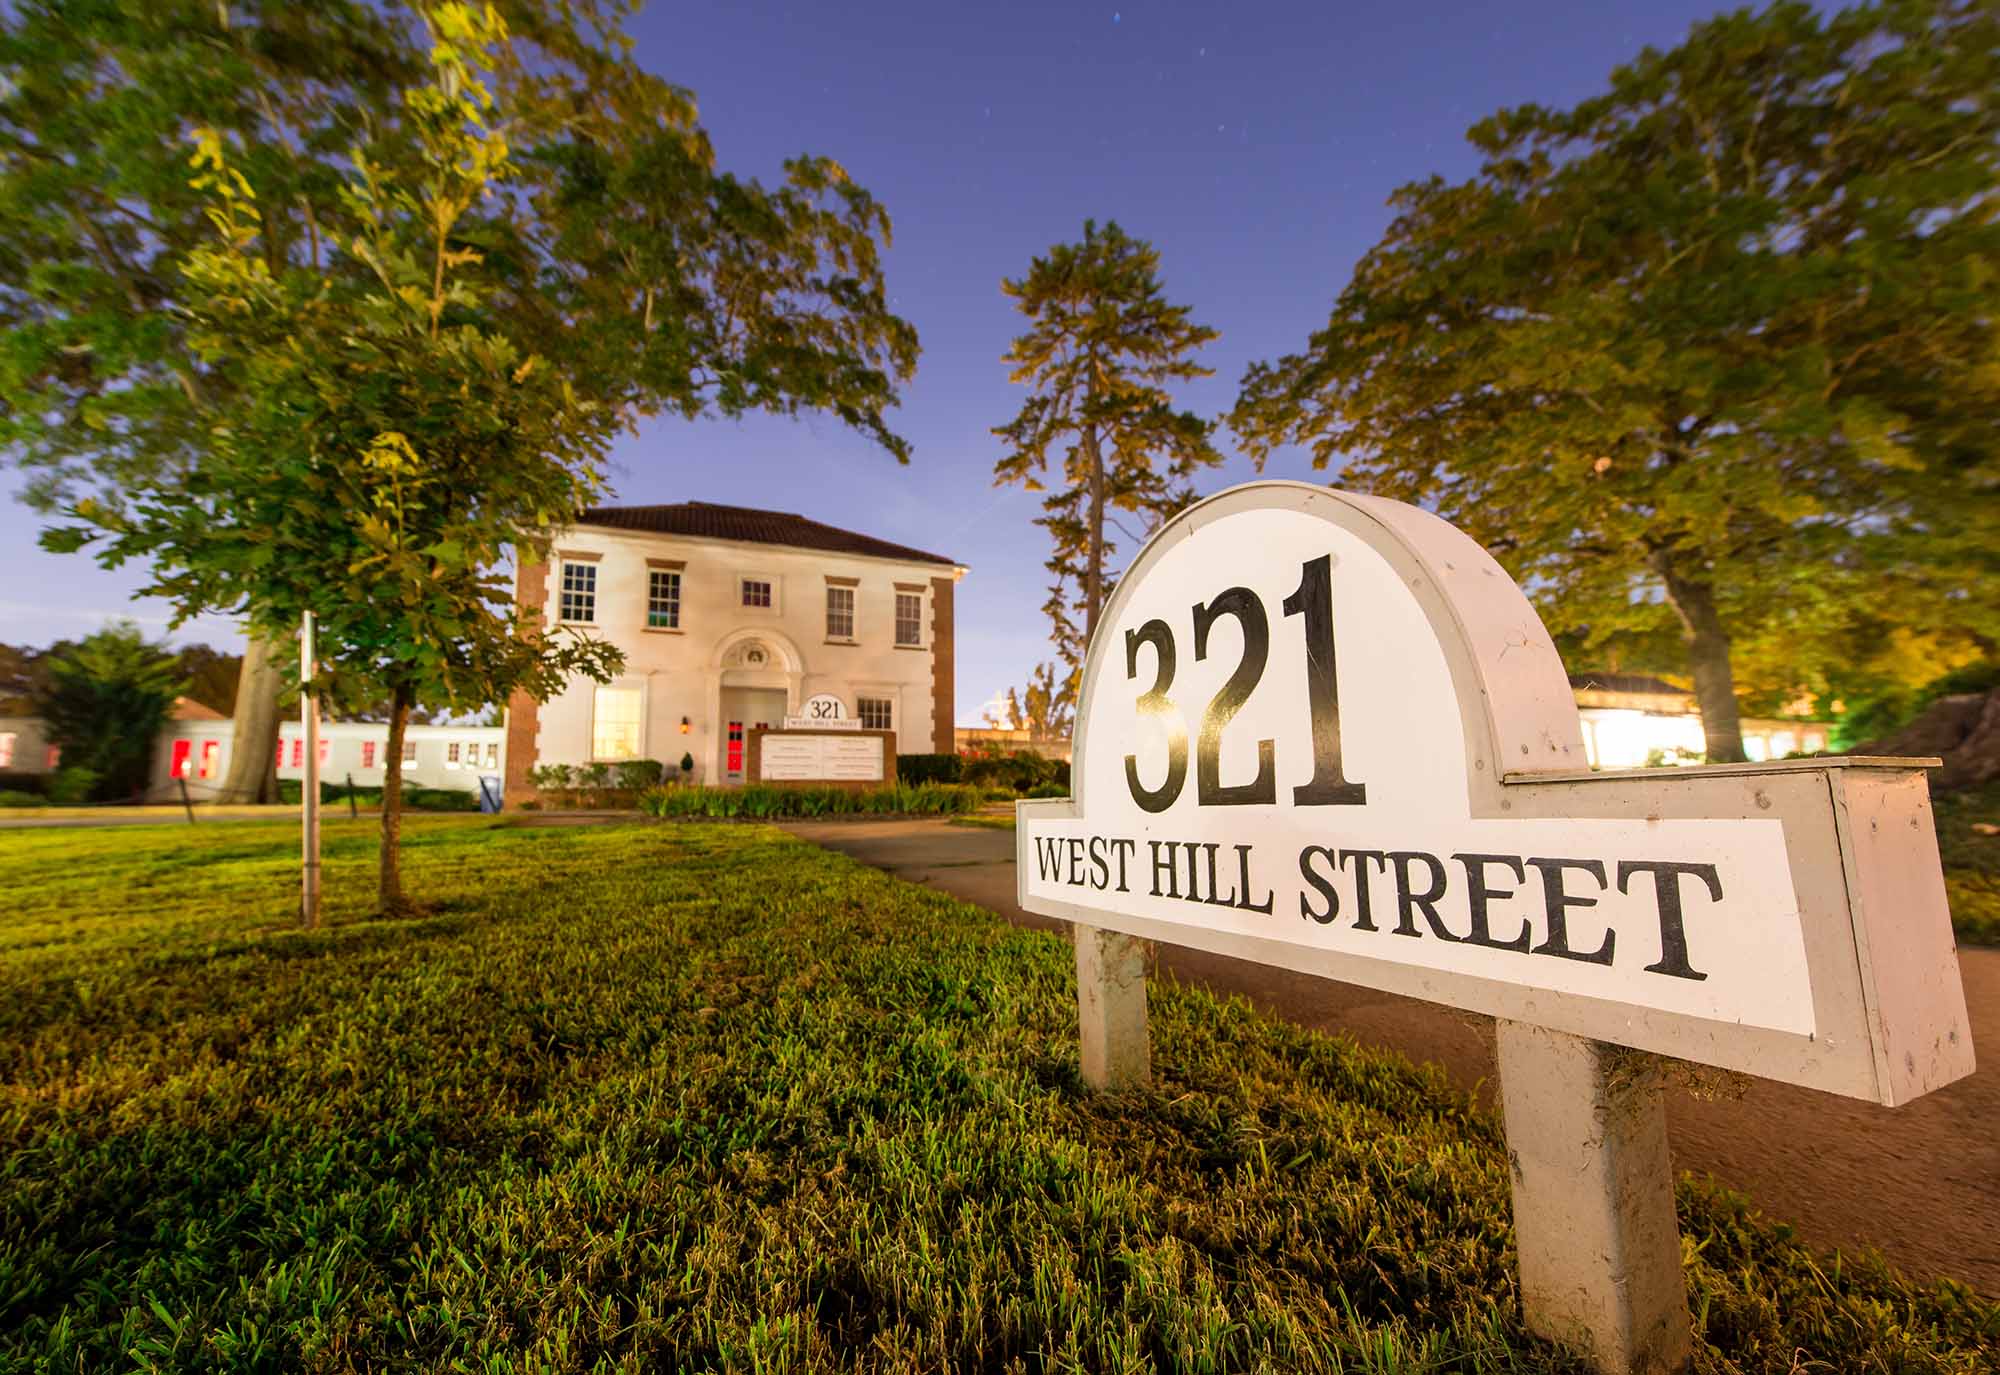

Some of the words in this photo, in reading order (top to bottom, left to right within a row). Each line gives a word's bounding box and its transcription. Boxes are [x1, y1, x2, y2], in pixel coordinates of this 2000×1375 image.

[811, 701, 839, 719] 321
[1124, 554, 1366, 813] 321
[1035, 837, 1136, 893] WEST
[1148, 841, 1274, 915] HILL
[1300, 845, 1723, 981] STREET
